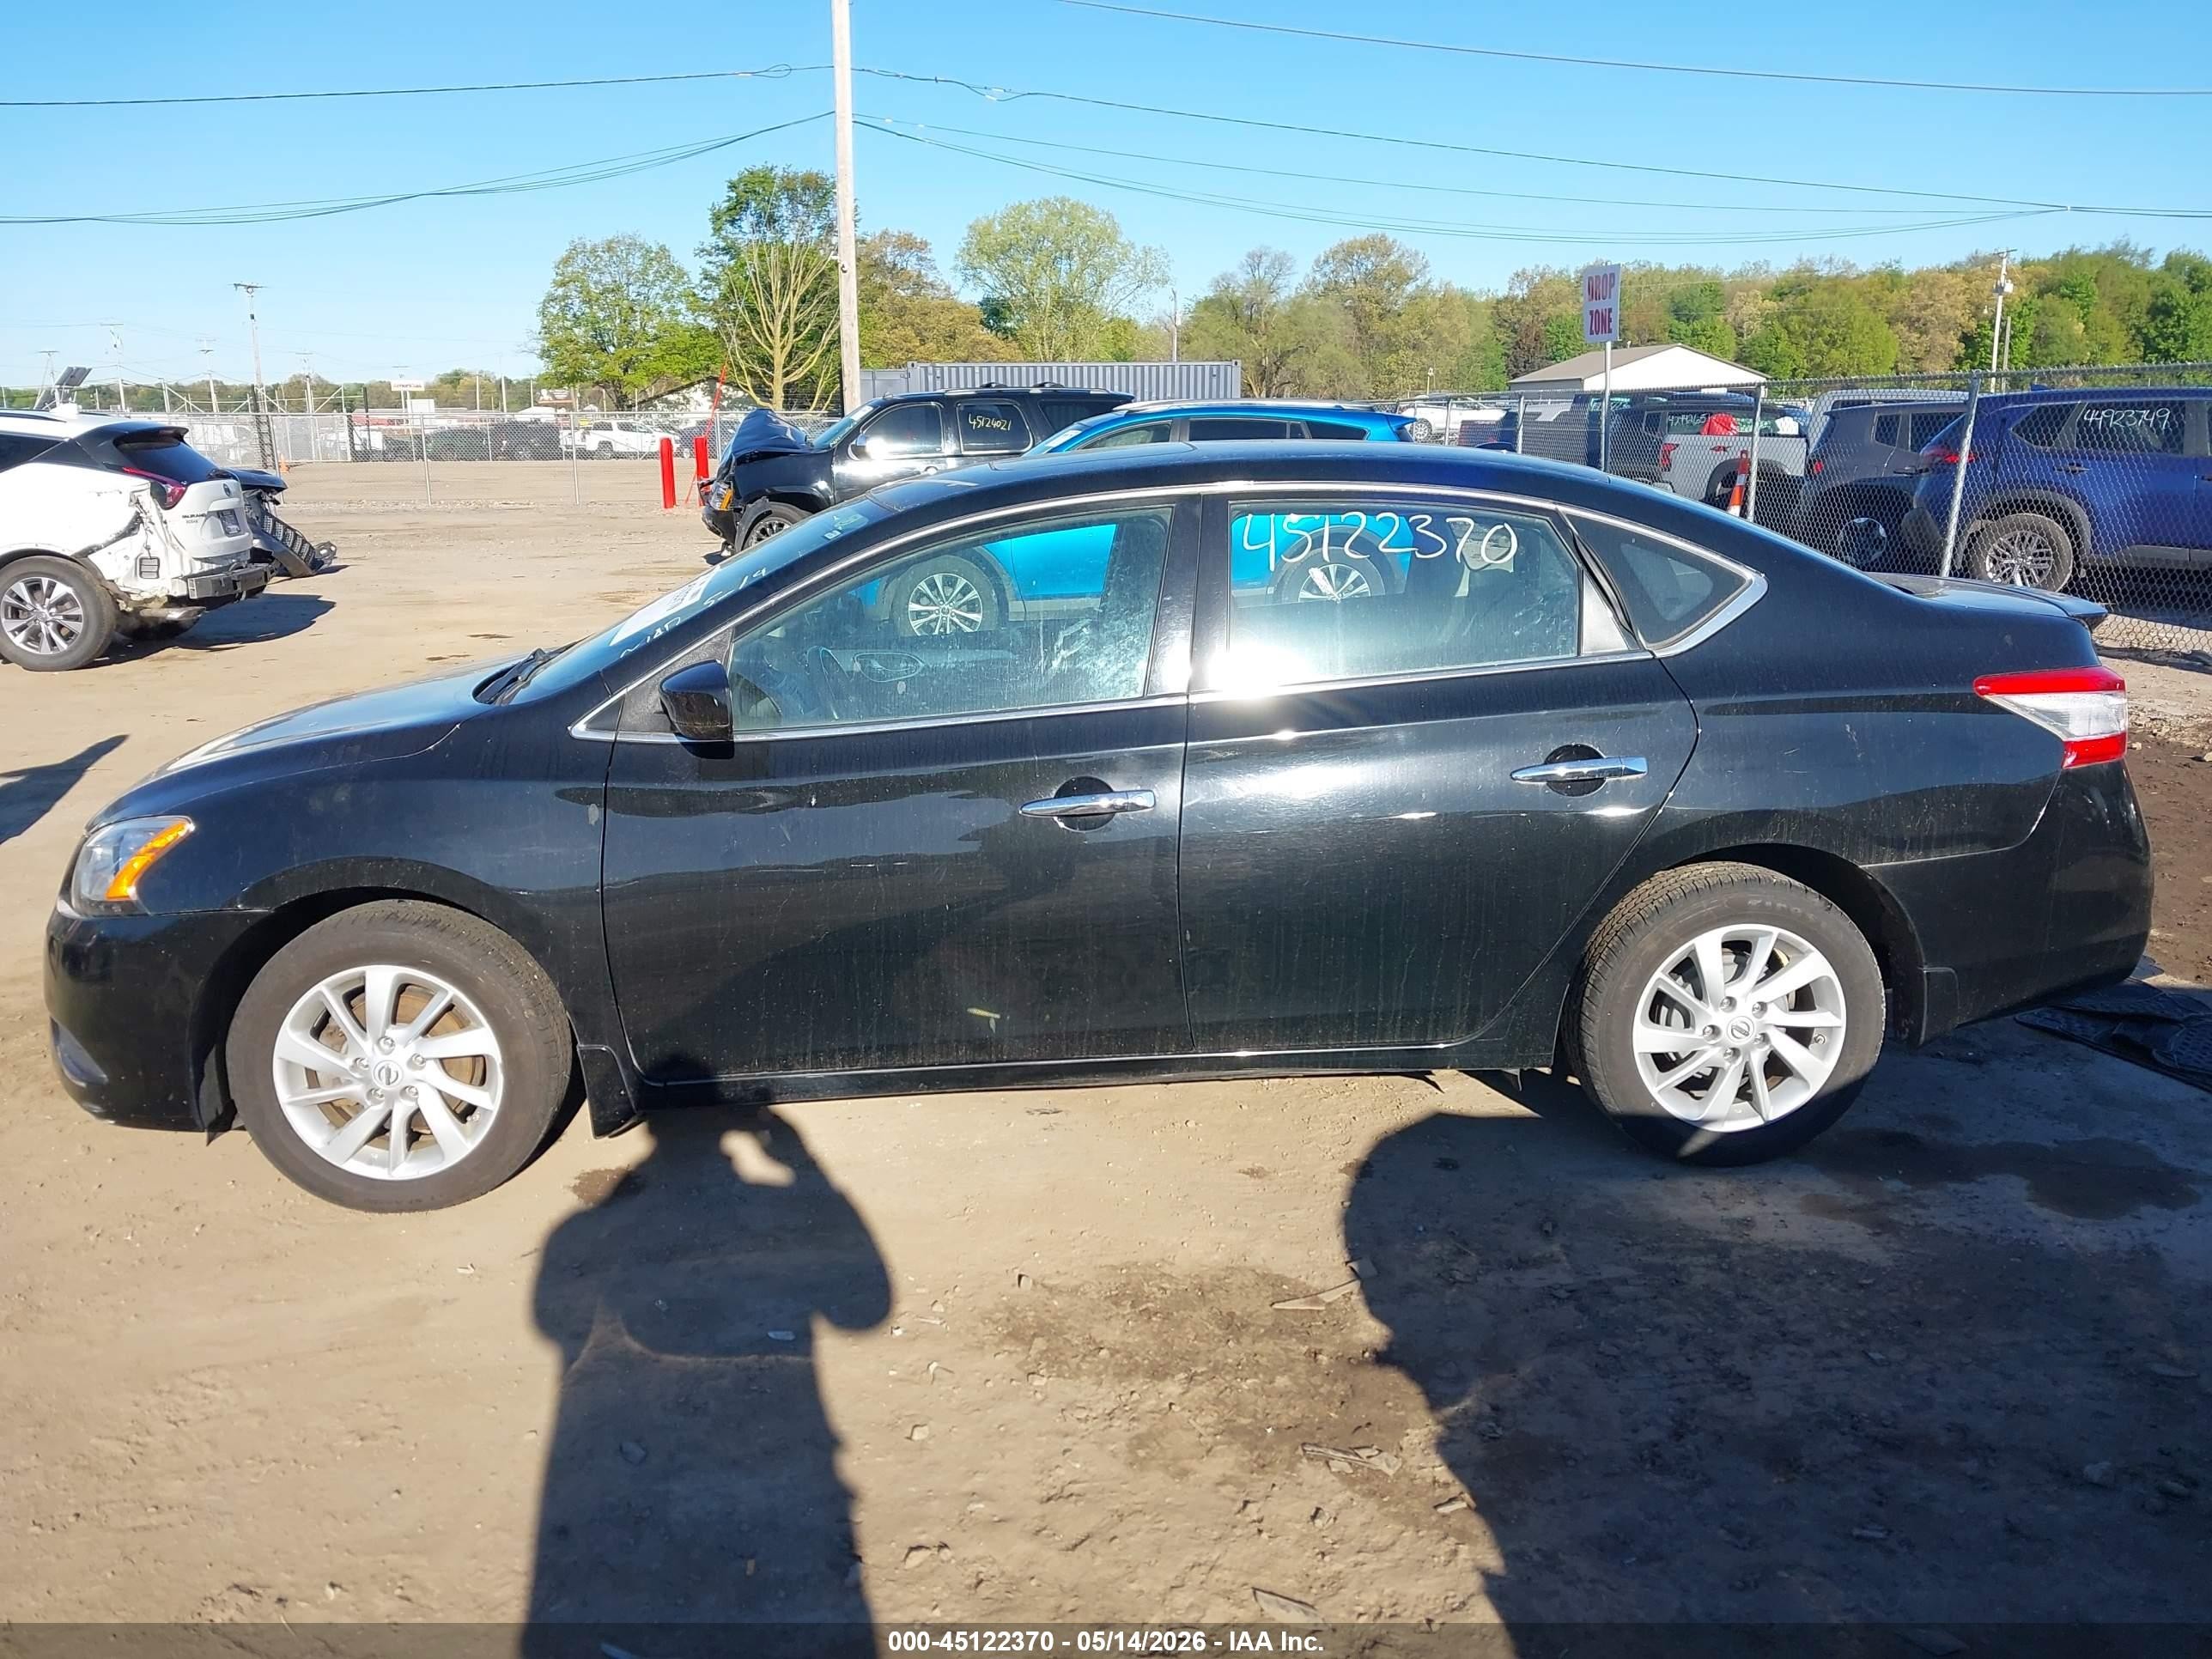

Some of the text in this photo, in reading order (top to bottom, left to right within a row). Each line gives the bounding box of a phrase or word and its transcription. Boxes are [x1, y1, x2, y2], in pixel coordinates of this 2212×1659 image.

[1588, 272, 1615, 301] DROP
[1589, 307, 1613, 335] ZONE
[968, 413, 1012, 431] 45124021
[2083, 408, 2171, 429] 44923749
[1243, 511, 1518, 572] 45122370
